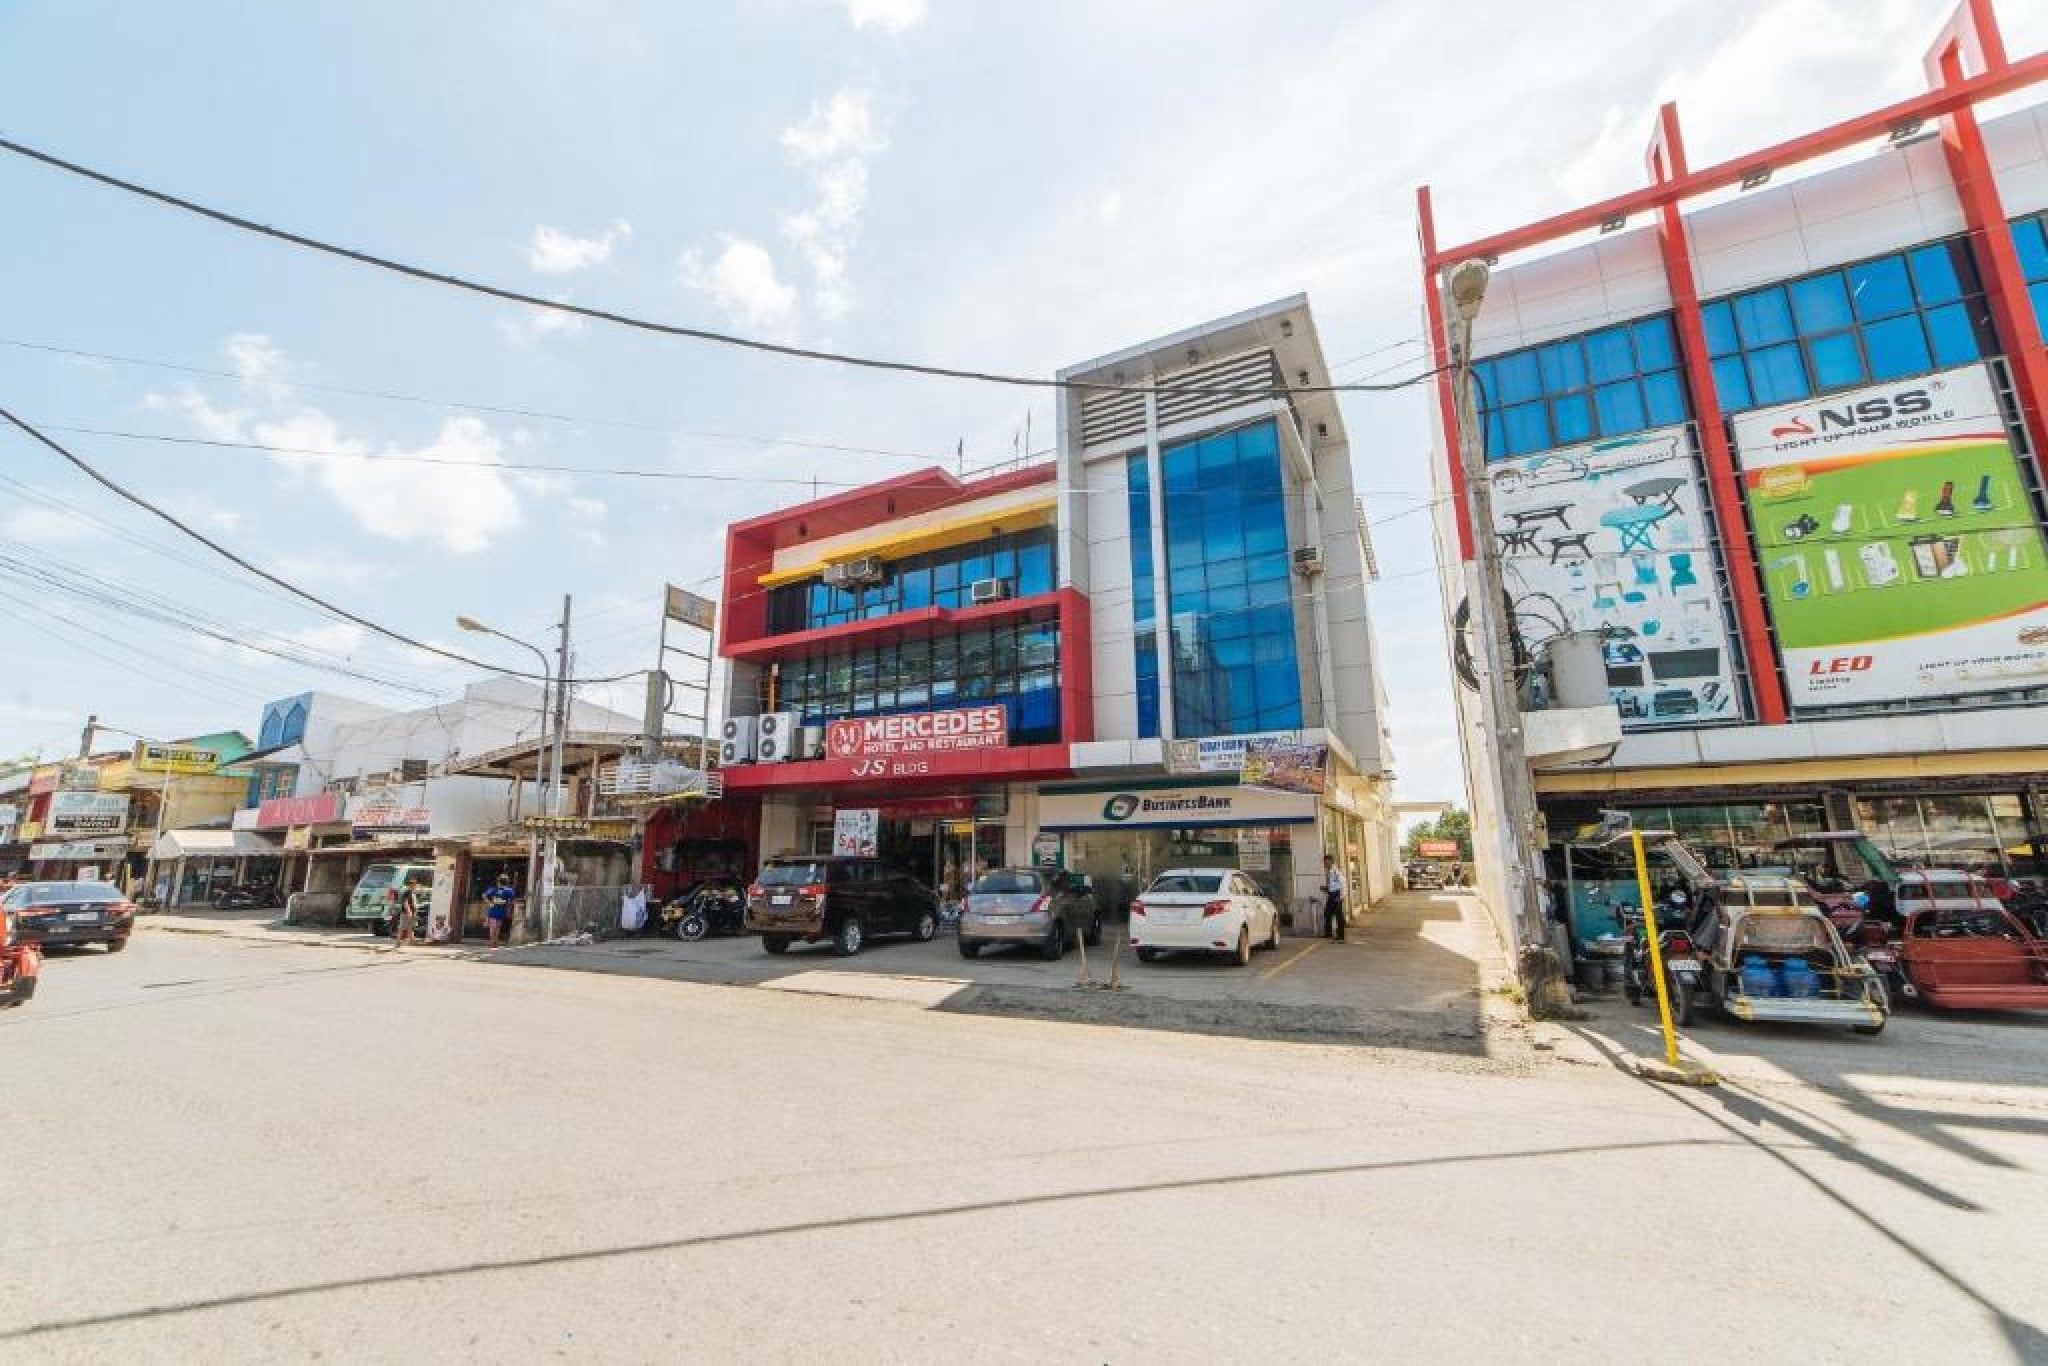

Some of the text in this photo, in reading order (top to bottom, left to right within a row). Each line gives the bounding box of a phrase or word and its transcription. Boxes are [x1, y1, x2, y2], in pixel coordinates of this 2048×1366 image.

[1818, 390, 1931, 431] NSS
[1810, 655, 1873, 674] LED
[864, 709, 1000, 741] MERCEDES
[864, 734, 1000, 755] HOTEL AND RESTAURANT
[852, 760, 886, 777] JS
